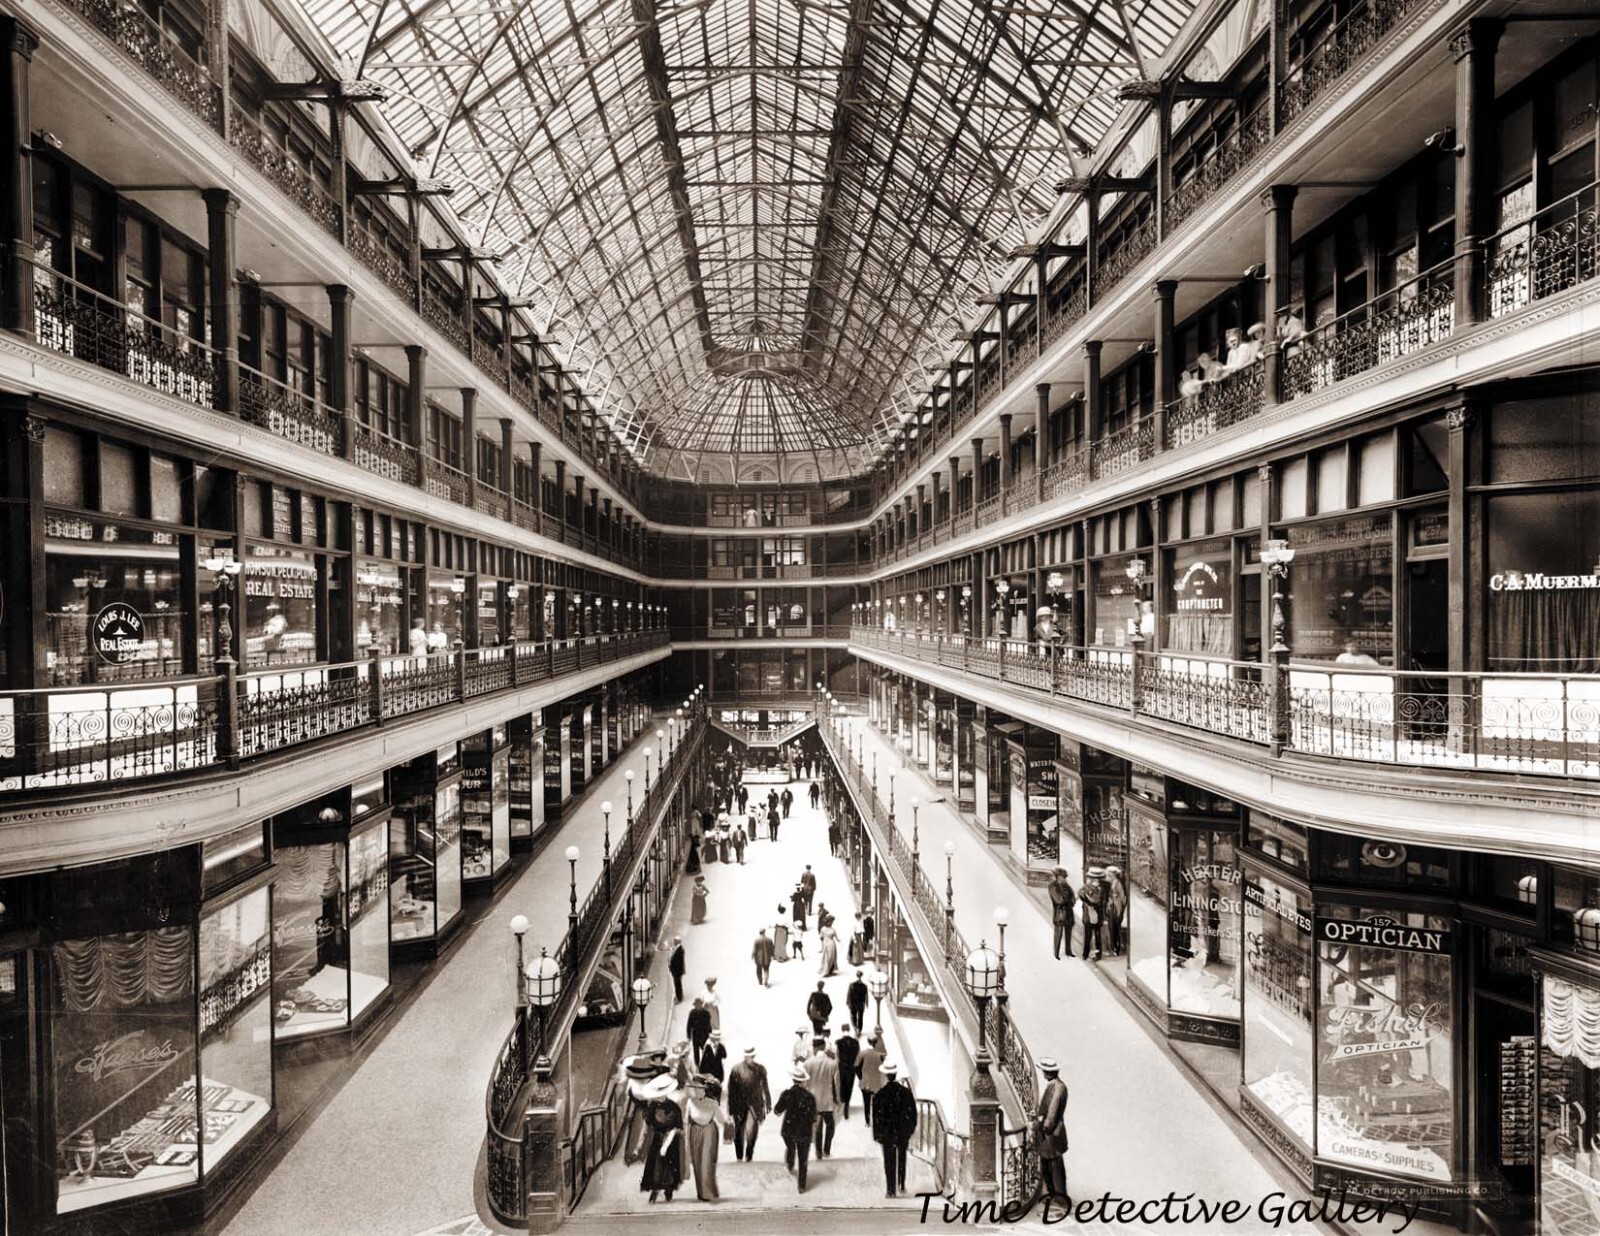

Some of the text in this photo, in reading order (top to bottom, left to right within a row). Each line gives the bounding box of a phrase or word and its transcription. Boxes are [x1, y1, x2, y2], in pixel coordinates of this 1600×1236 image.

[245, 581, 314, 599] REAL ESTATE
[98, 609, 141, 633] LOUIS J. LEE
[100, 636, 139, 652] REAL ESTATE
[1173, 891, 1260, 918] LINING STORE
[1244, 885, 1312, 932] ARTIFICIAL EYES
[1373, 917, 1392, 927] 157
[1324, 921, 1443, 951] OPTICIAN
[1343, 1039, 1421, 1055] OPTICIAN
[1331, 1142, 1378, 1161] CAMERAS
[1383, 1152, 1435, 1173] SUPPLIES
